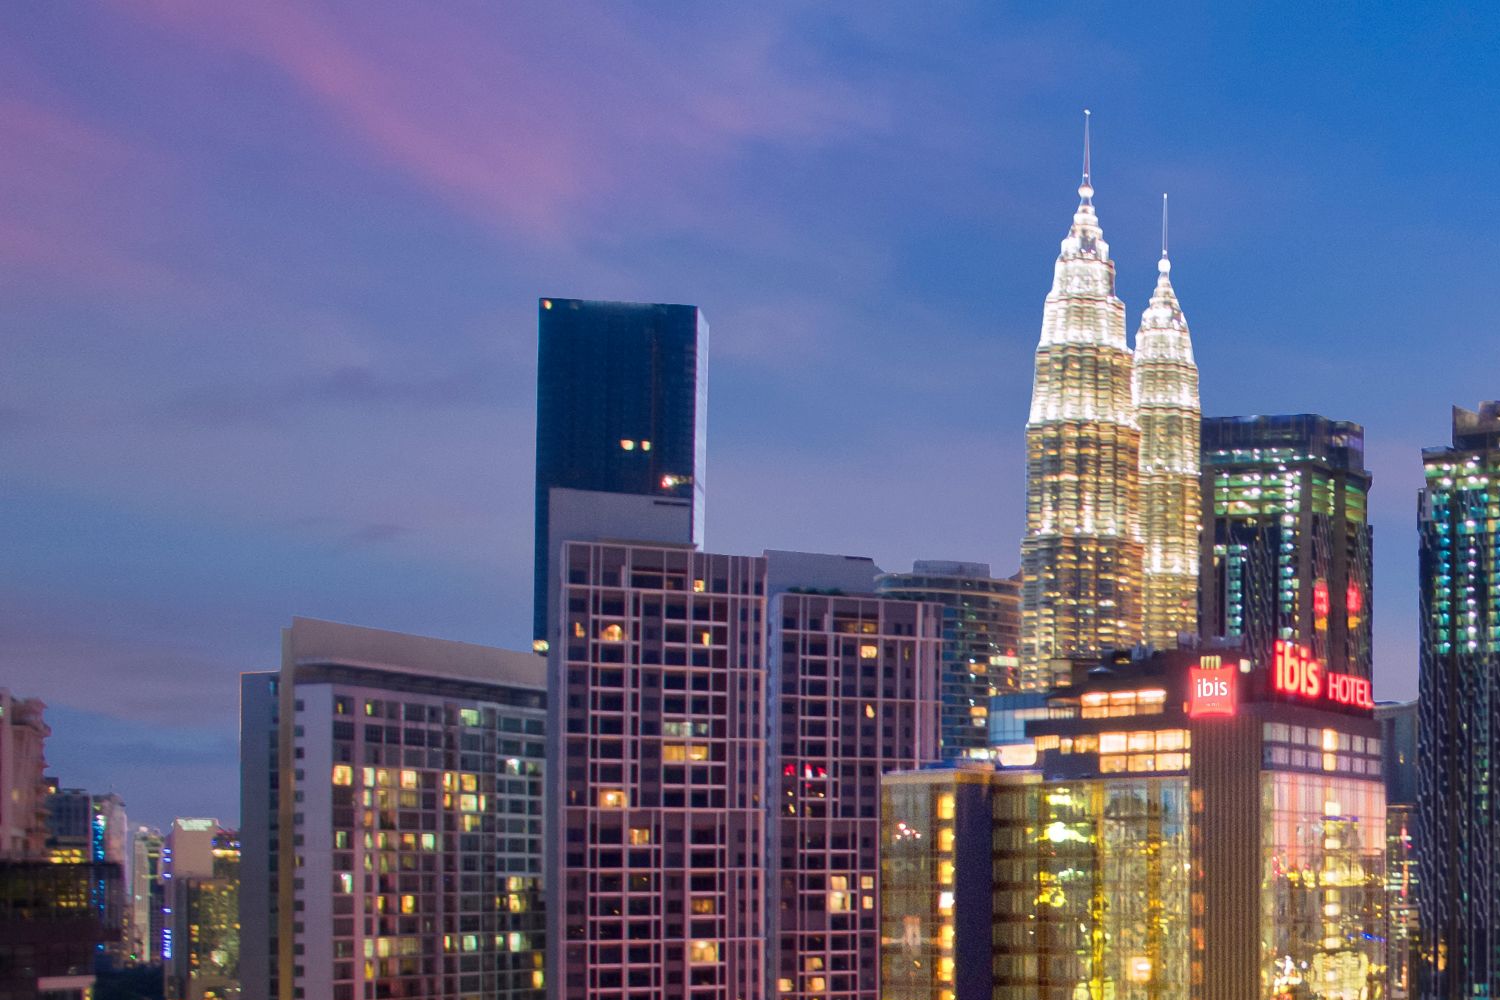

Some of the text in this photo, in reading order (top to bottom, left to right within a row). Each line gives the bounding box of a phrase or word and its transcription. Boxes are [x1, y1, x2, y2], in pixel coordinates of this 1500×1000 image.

[1197, 676, 1228, 698] ibis
[1276, 641, 1375, 709] ibis HOTEL
